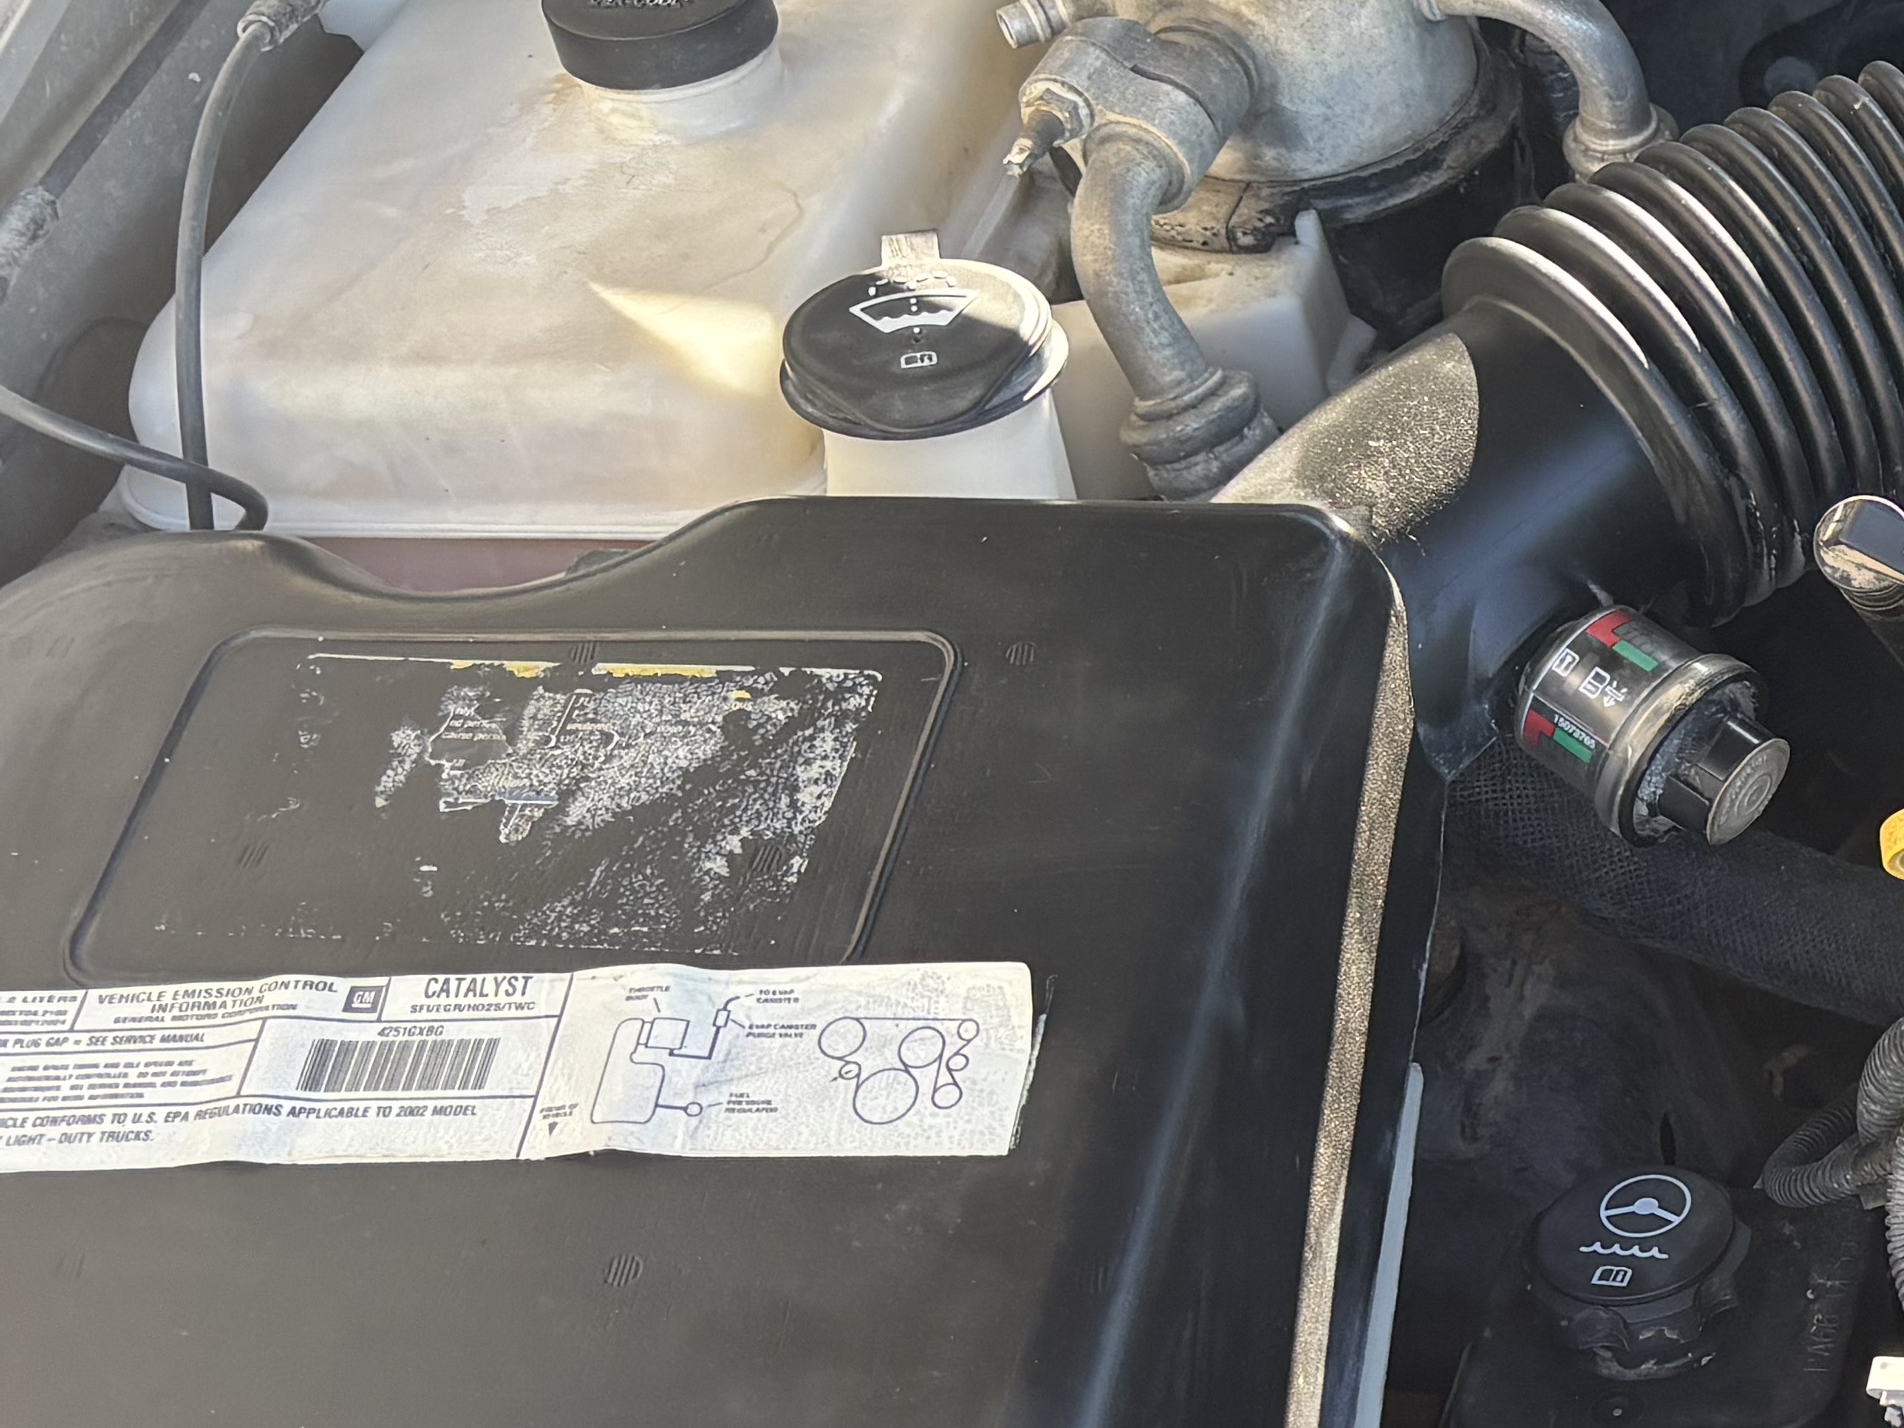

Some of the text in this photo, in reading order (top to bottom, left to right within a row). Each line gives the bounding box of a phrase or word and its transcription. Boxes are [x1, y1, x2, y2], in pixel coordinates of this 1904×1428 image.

[98, 979, 338, 1004] VEHICLE EMISSION CONTROL
[424, 975, 534, 999] CATALYST
[151, 995, 265, 1014] INFORMATION
[12, 1038, 42, 1048] PLUG
[46, 1036, 69, 1047] GAP
[86, 1035, 109, 1046] SEE
[110, 1034, 157, 1046] SERVICE
[159, 1033, 206, 1044] MANUAL
[31, 1113, 105, 1128] CONFORMS
[110, 1112, 128, 1124] TO
[132, 1112, 157, 1124] U.S.
[163, 1111, 190, 1123] EPA
[194, 1103, 283, 1121] REGULATIONS
[286, 1104, 371, 1119] APPLICABLE
[376, 1105, 393, 1117] TO
[398, 1105, 427, 1117] 2002
[430, 1104, 477, 1116] MODEL
[99, 1129, 155, 1144] TRUCKS.
